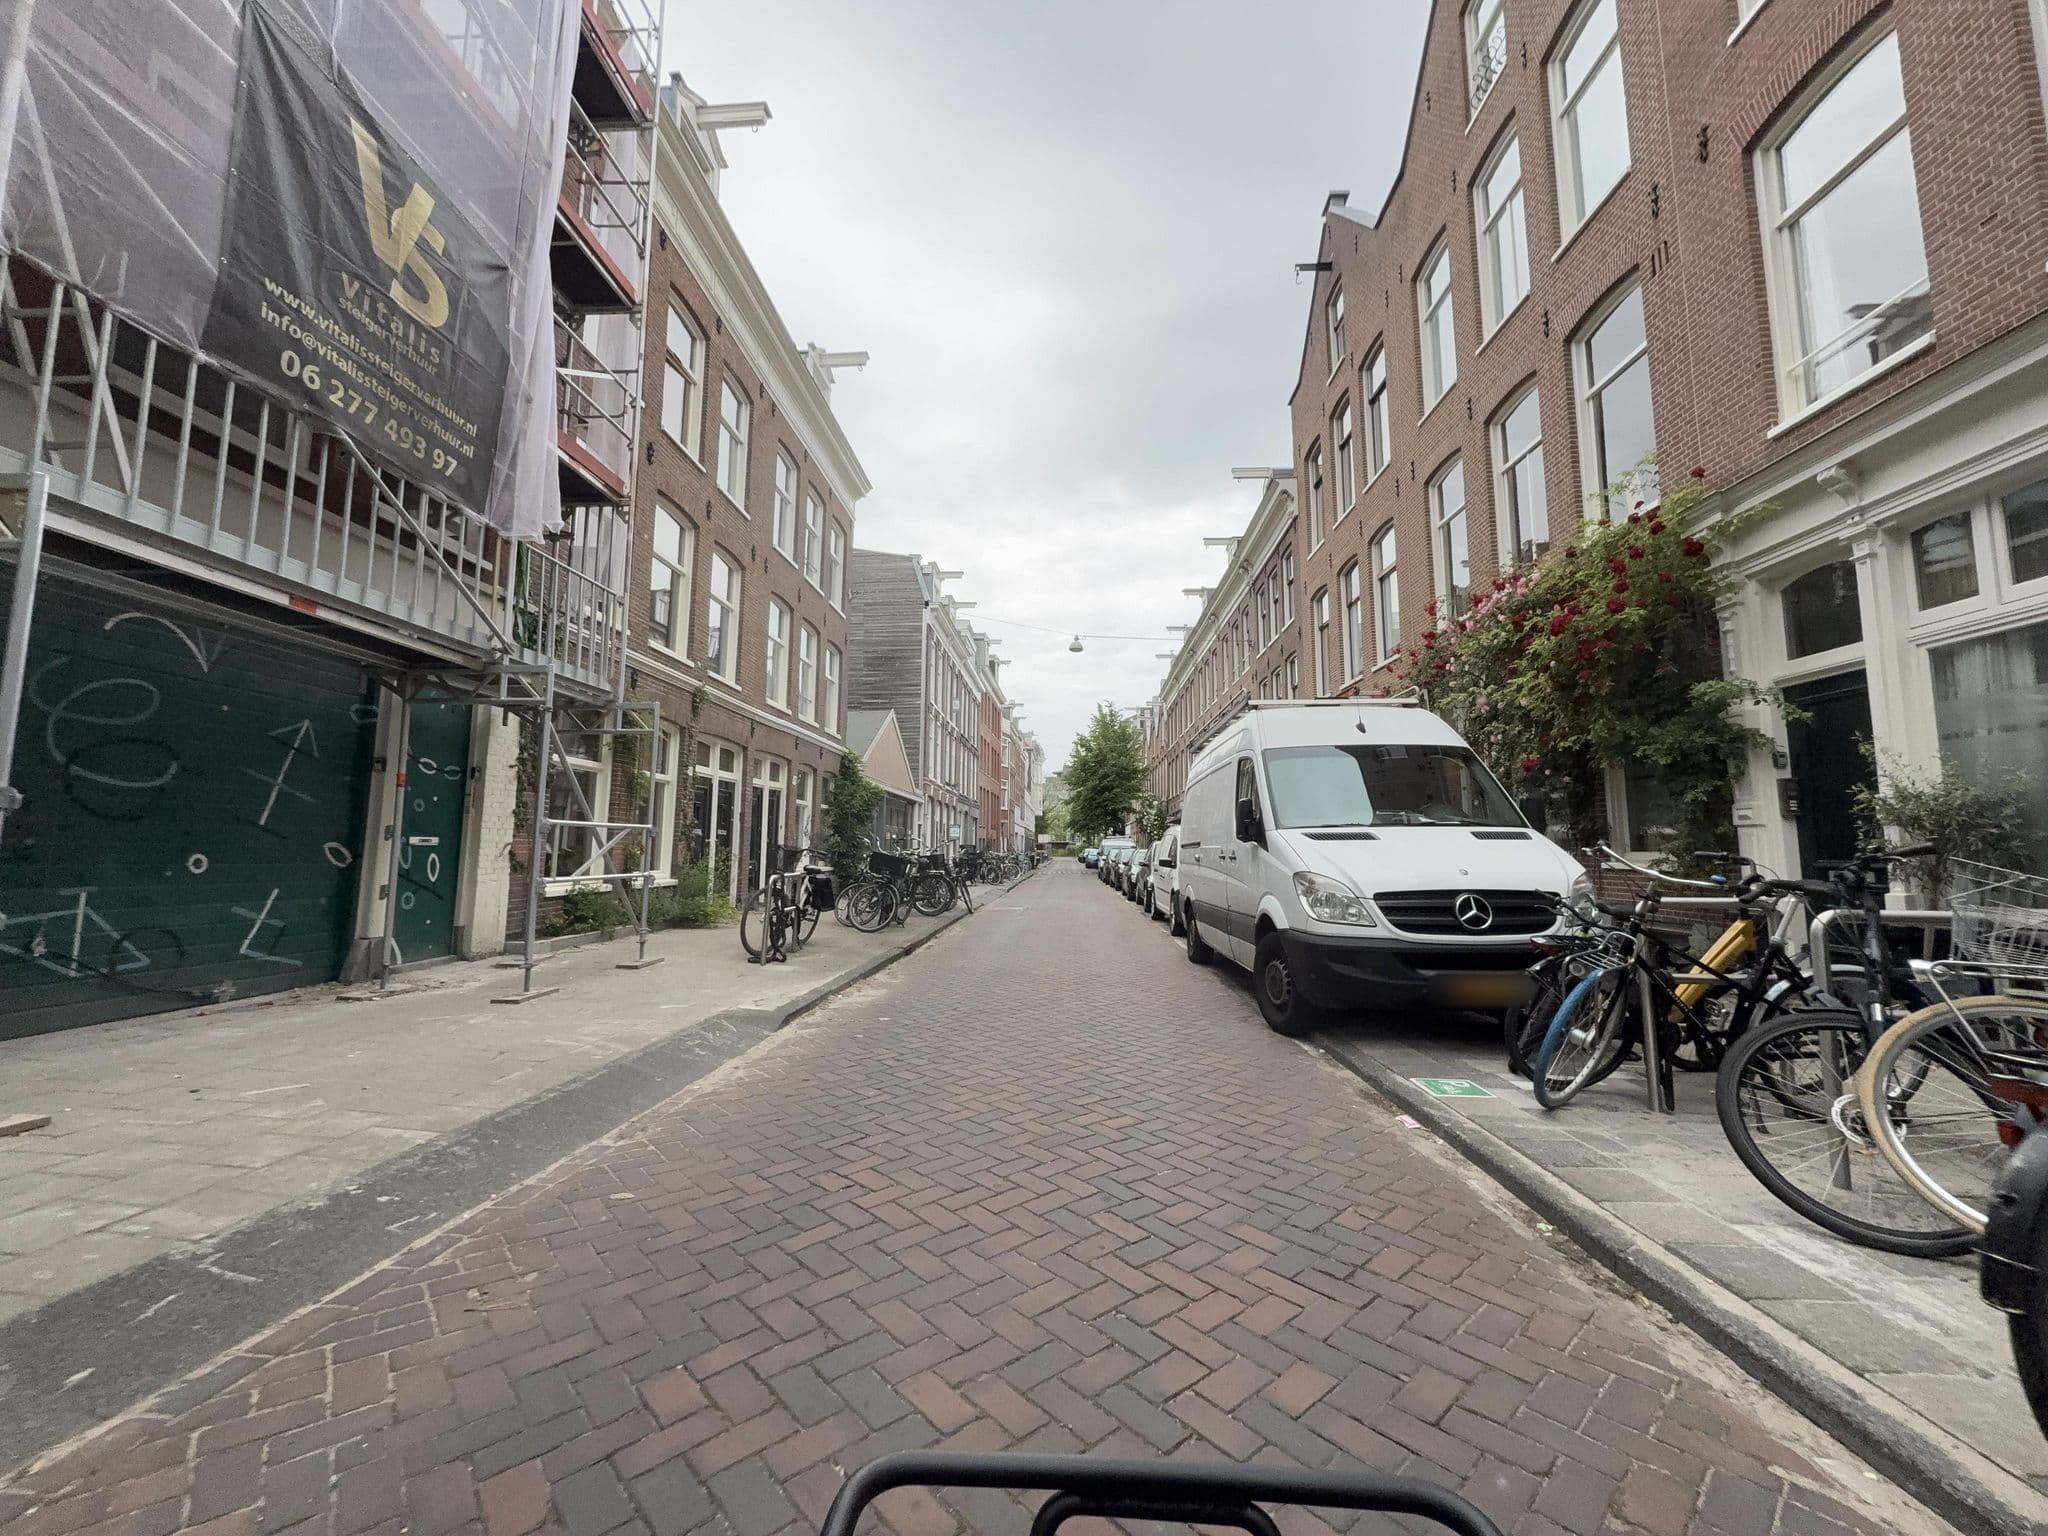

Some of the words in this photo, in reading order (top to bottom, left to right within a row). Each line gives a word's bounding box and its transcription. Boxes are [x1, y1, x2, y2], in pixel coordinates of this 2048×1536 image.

[261, 301, 475, 459] info@vitalissteigerverhuur.nl
[264, 277, 478, 438] www.vitalissteigerverhuur.nl
[342, 271, 440, 364] Vitalis
[281, 350, 321, 390] 06
[328, 379, 378, 425] 277
[384, 418, 428, 459] 493
[432, 448, 458, 477] 97
